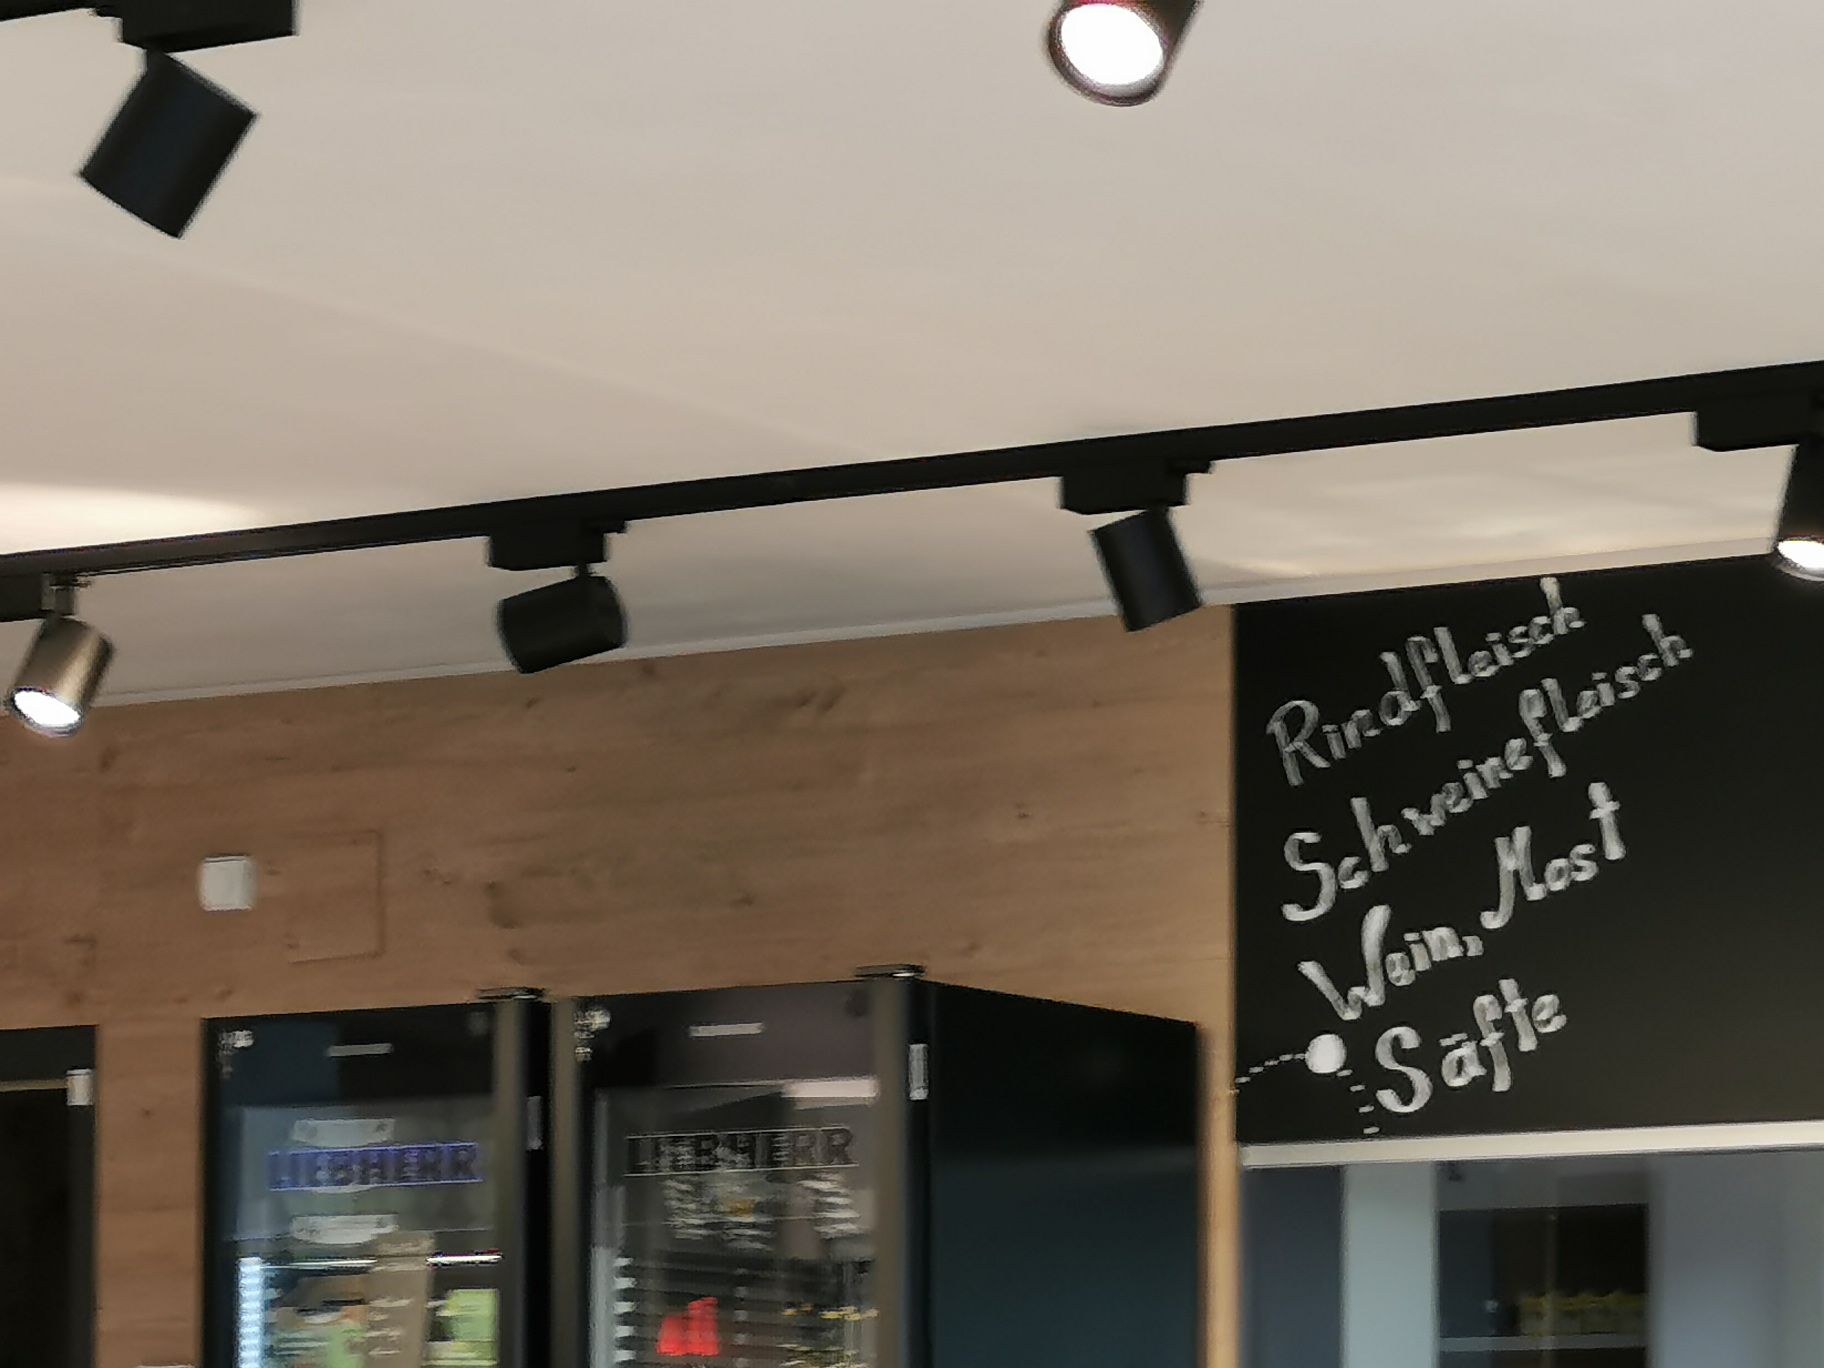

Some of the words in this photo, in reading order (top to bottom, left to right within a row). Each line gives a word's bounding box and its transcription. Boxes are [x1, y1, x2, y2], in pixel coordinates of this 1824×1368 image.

[1266, 576, 1586, 786] Rindfleisch
[1282, 613, 1694, 921] Schweinefleisch
[1298, 904, 1485, 1021] Wein,
[1480, 782, 1627, 929] Most
[1375, 977, 1567, 1113] Säfte
